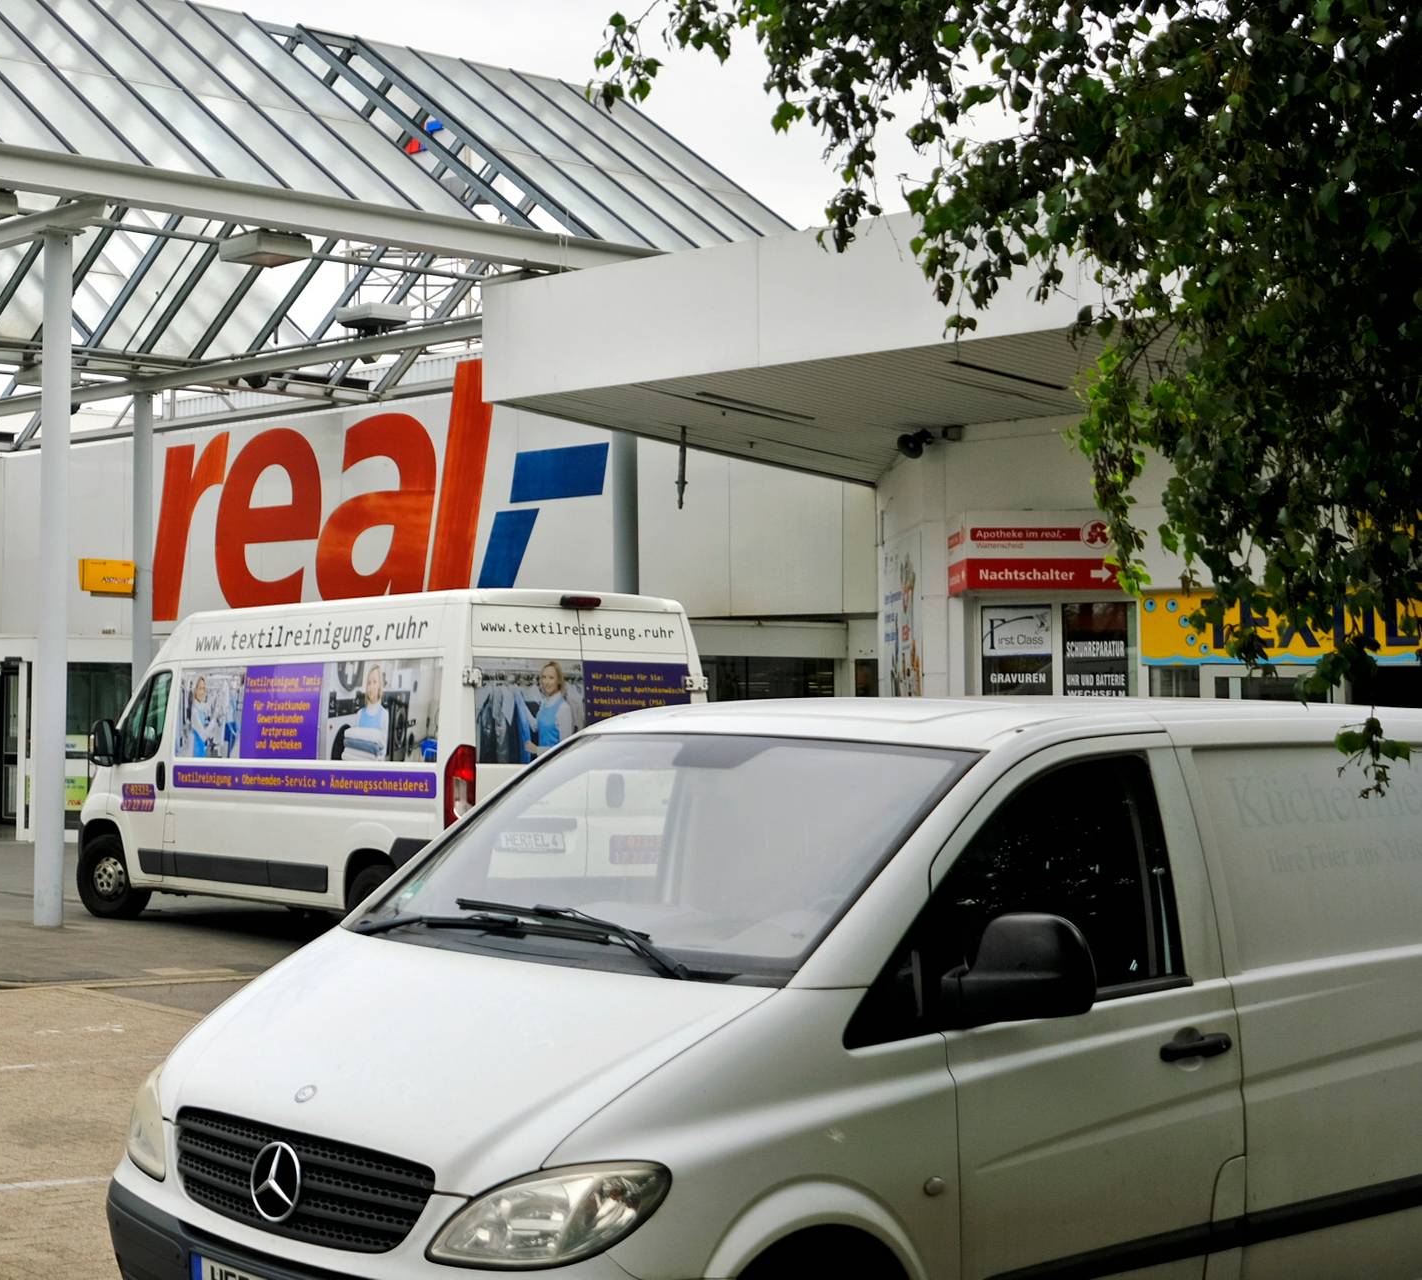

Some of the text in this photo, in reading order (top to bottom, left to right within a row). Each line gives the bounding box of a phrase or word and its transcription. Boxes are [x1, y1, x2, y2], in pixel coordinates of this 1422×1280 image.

[976, 529, 1023, 540] Apotheke
[1026, 530, 1039, 538] im
[979, 568, 1076, 581] Nachtschalter
[195, 615, 429, 652] www.textilreinigung.ruhr
[480, 621, 675, 641] www.textilreinigung.ruhr
[1066, 640, 1125, 658] SCHUHREPARATUR
[990, 672, 1047, 684] GRAVUREN
[1066, 673, 1125, 686] UHR UND BATTERIE
[267, 700, 311, 711] Privatkunden
[269, 739, 303, 751] Apotheken
[177, 771, 430, 793] Textilreinigung Oberhemden-Service Änderungsschneiderei
